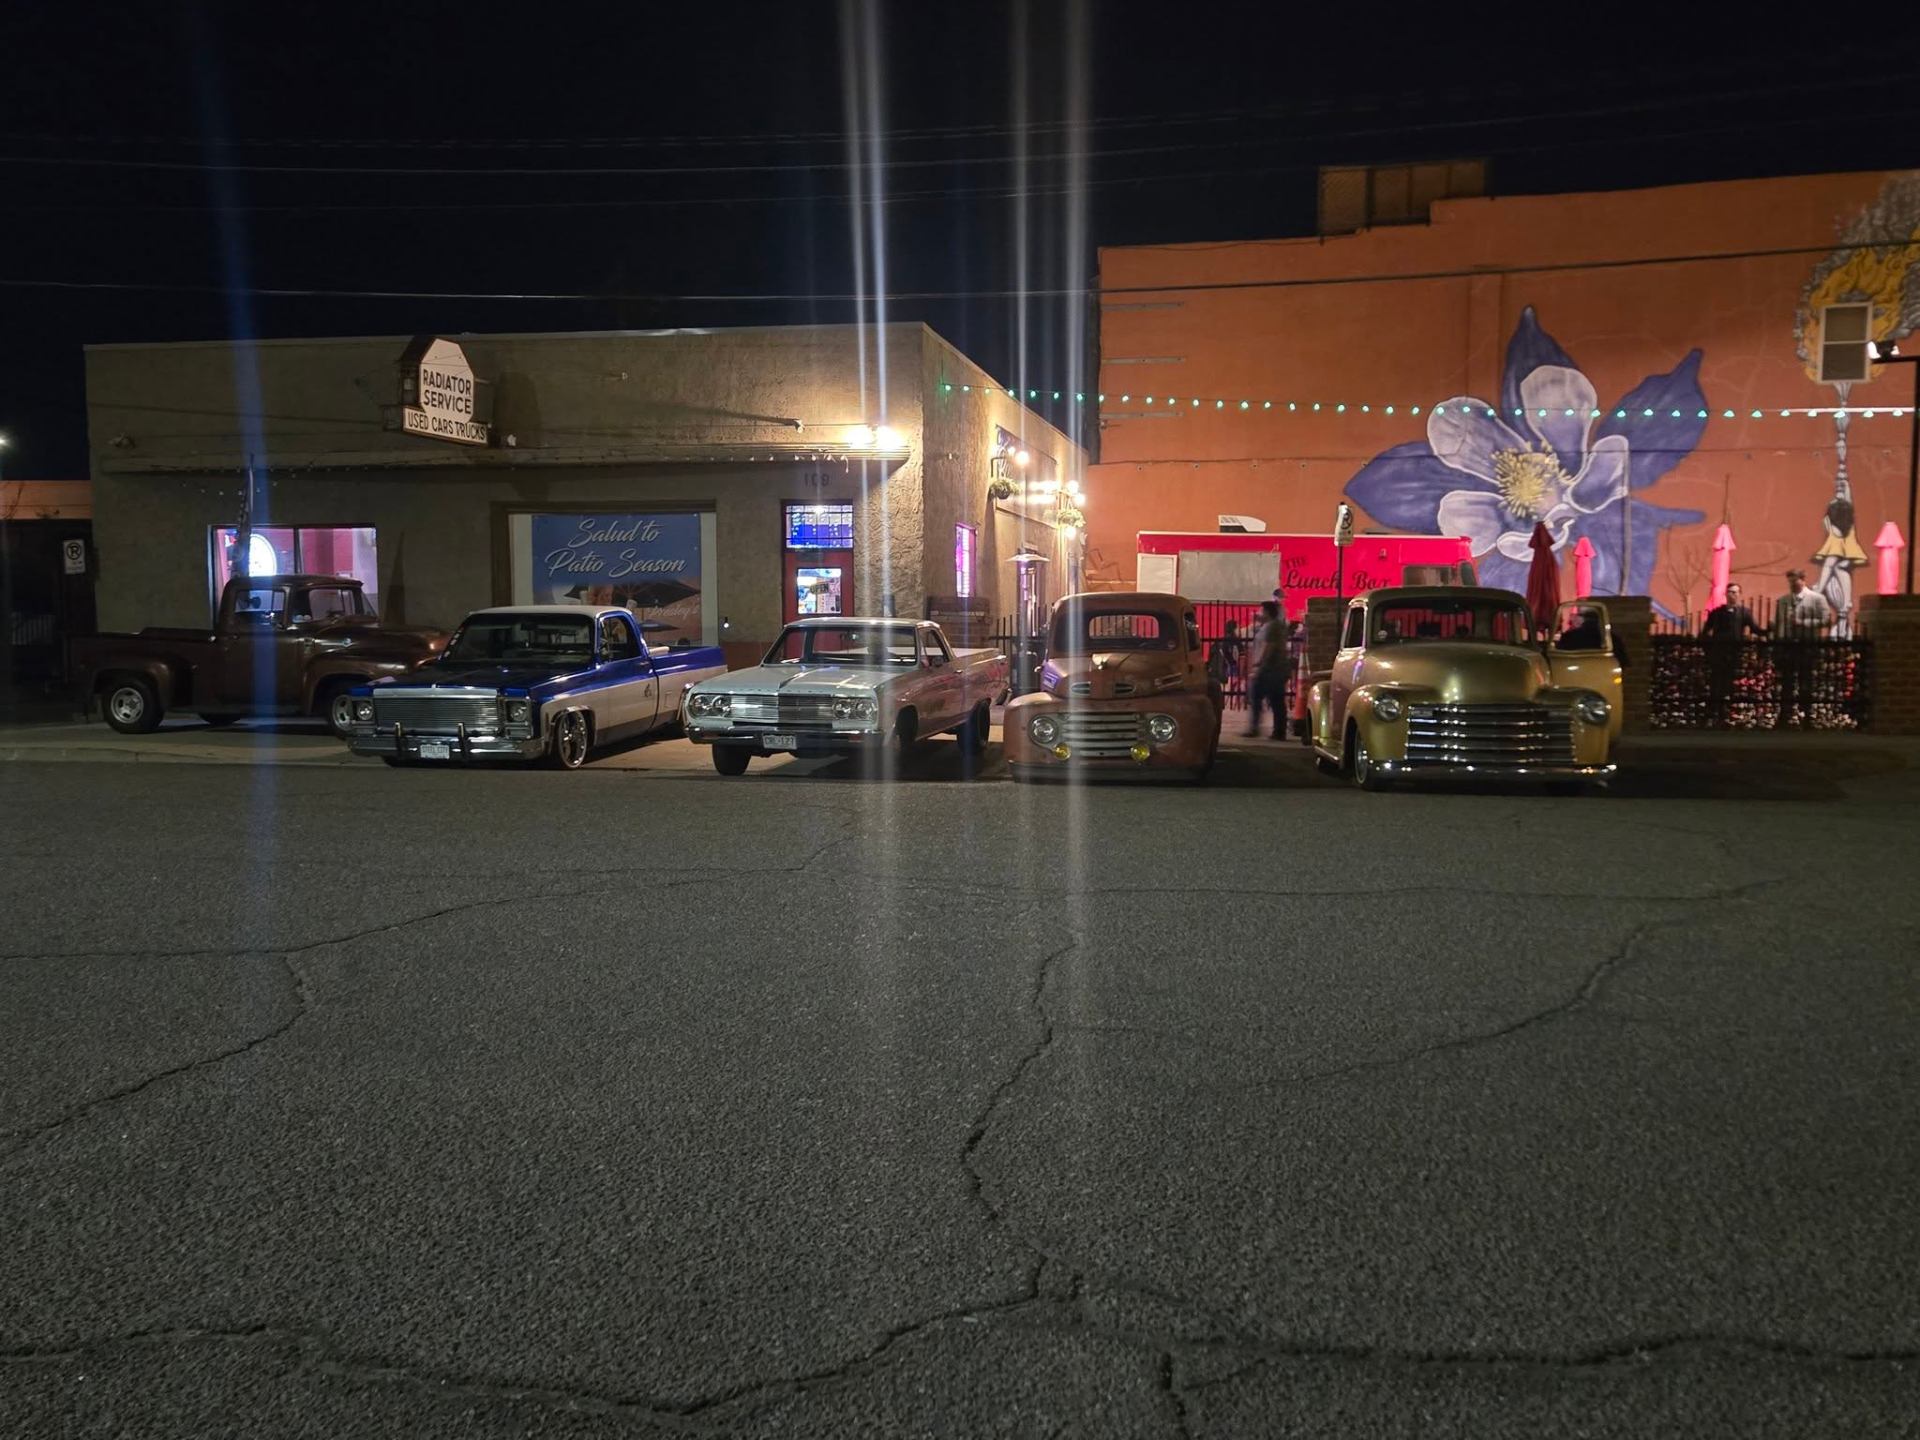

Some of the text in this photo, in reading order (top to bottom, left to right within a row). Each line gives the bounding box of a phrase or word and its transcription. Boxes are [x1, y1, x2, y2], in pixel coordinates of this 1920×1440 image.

[423, 369, 471, 396] RADIATOR
[423, 389, 471, 414] SERVICE
[407, 411, 486, 440] USED CARS TRUCKS
[568, 518, 664, 548] Salud to
[545, 547, 686, 578] Patio Season
[1284, 569, 1341, 590] Lunch
